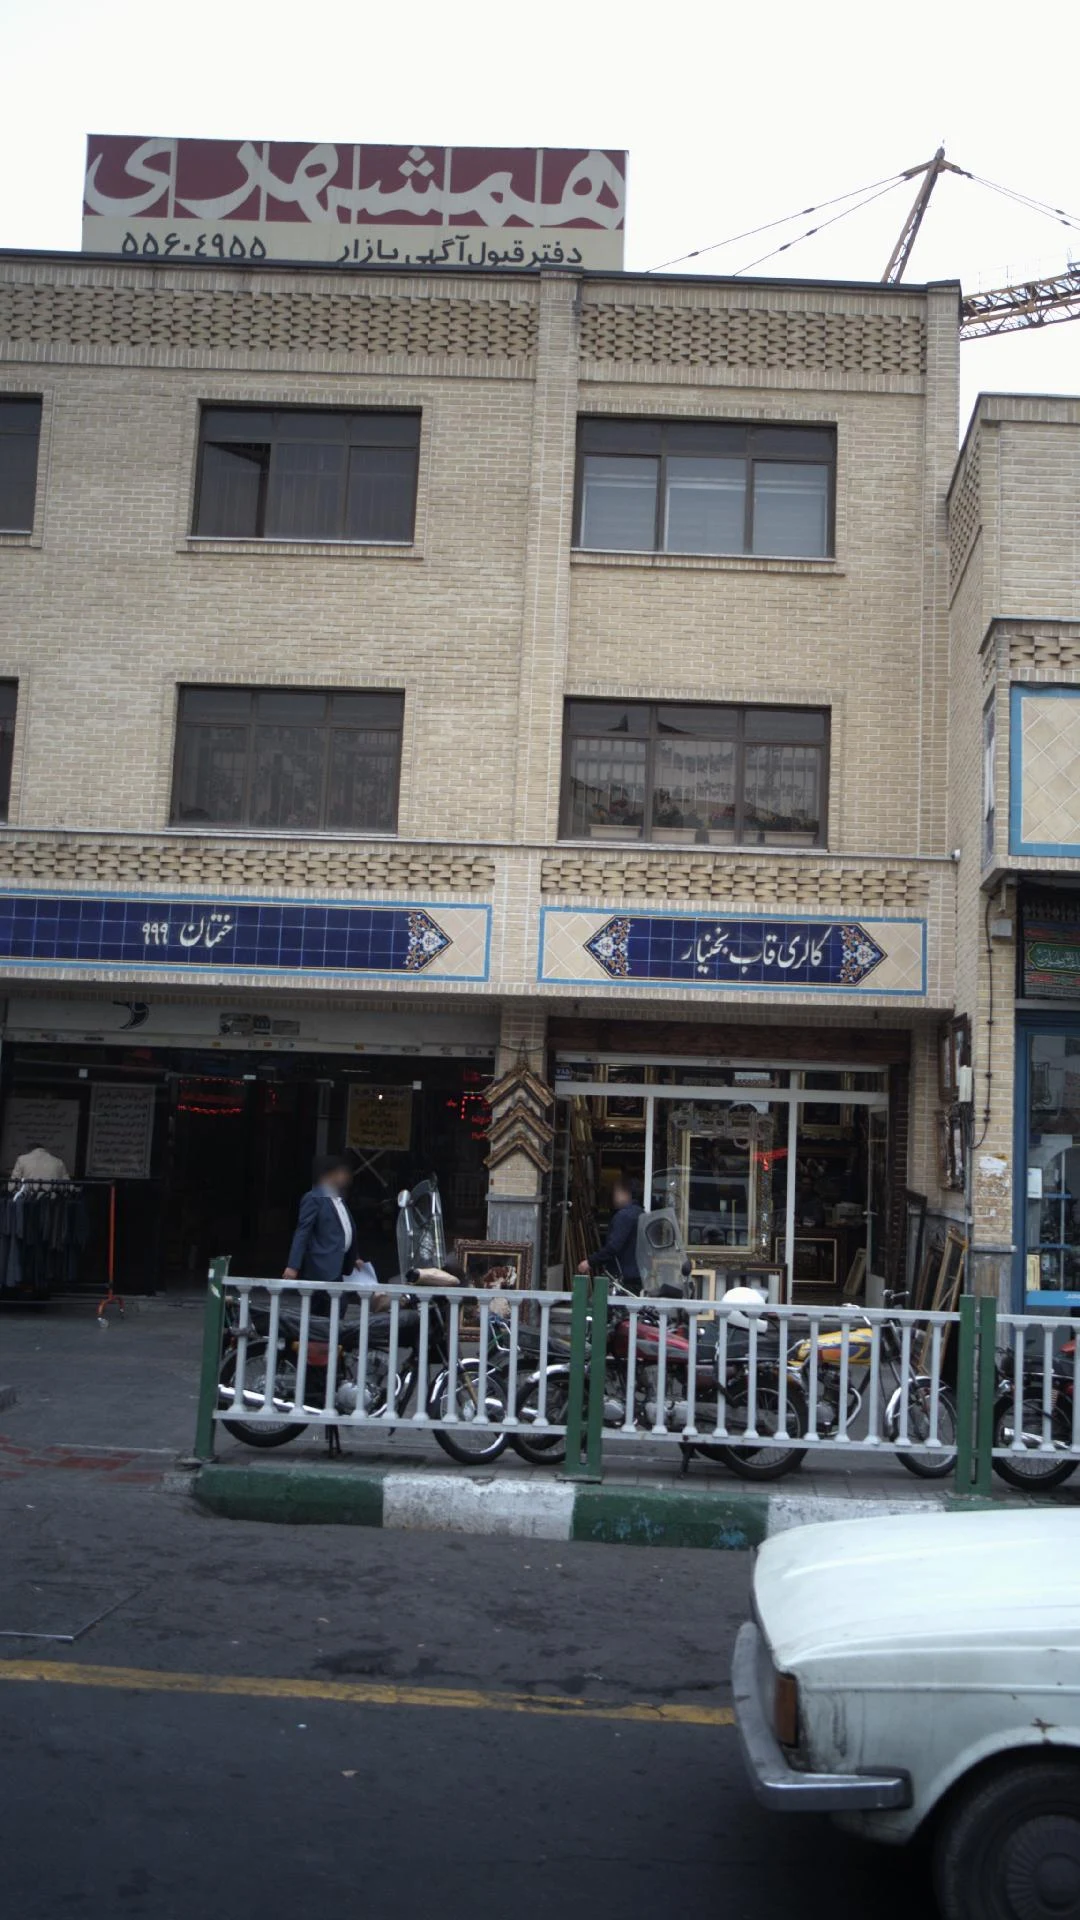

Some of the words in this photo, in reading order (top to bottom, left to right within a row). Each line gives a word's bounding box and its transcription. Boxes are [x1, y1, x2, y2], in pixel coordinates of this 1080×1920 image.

[83, 138, 626, 230] همشهری
[336, 239, 399, 264] بازار
[405, 234, 471, 264] آگهی
[468, 239, 526, 265] قبول
[529, 241, 583, 267] دفتر
[142, 921, 169, 945] ۹۹۹
[729, 934, 778, 974] قاب
